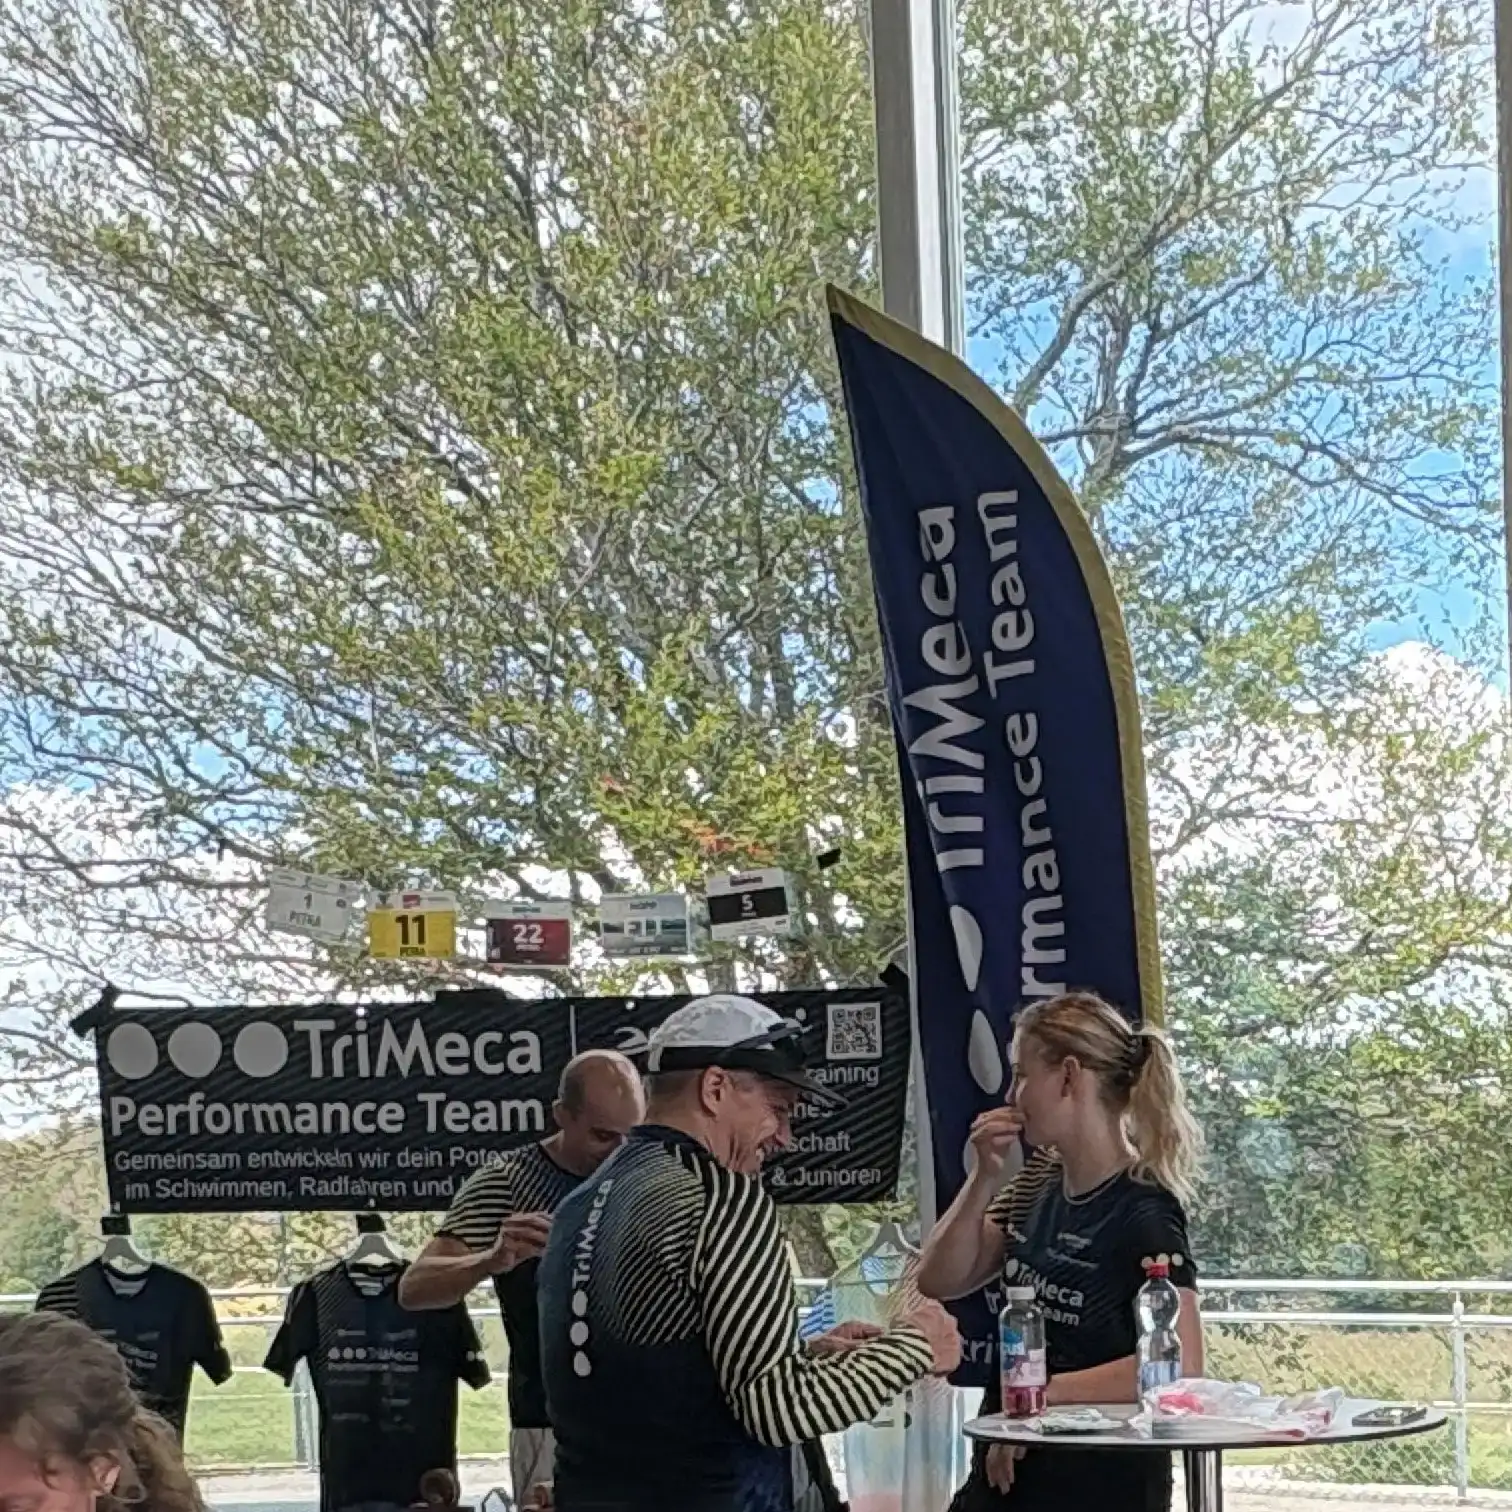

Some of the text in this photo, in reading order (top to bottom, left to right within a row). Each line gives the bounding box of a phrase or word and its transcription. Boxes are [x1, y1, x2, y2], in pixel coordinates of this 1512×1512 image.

[978, 489, 1067, 1001] rmance Team
[395, 914, 427, 946] 11
[511, 923, 545, 945] 22
[293, 1018, 542, 1079] TriMeca
[804, 1063, 880, 1088] raining
[110, 1092, 545, 1137] Performance Team
[785, 1131, 851, 1152] schaft
[114, 1150, 241, 1171] Gemeinsam
[247, 1148, 353, 1170] entwickeln
[358, 1147, 391, 1169] wir
[396, 1147, 443, 1169] dein
[125, 1179, 150, 1199] im
[300, 1176, 407, 1198] Radfahren
[413, 1175, 455, 1197] und
[771, 1165, 881, 1187] & Junioren
